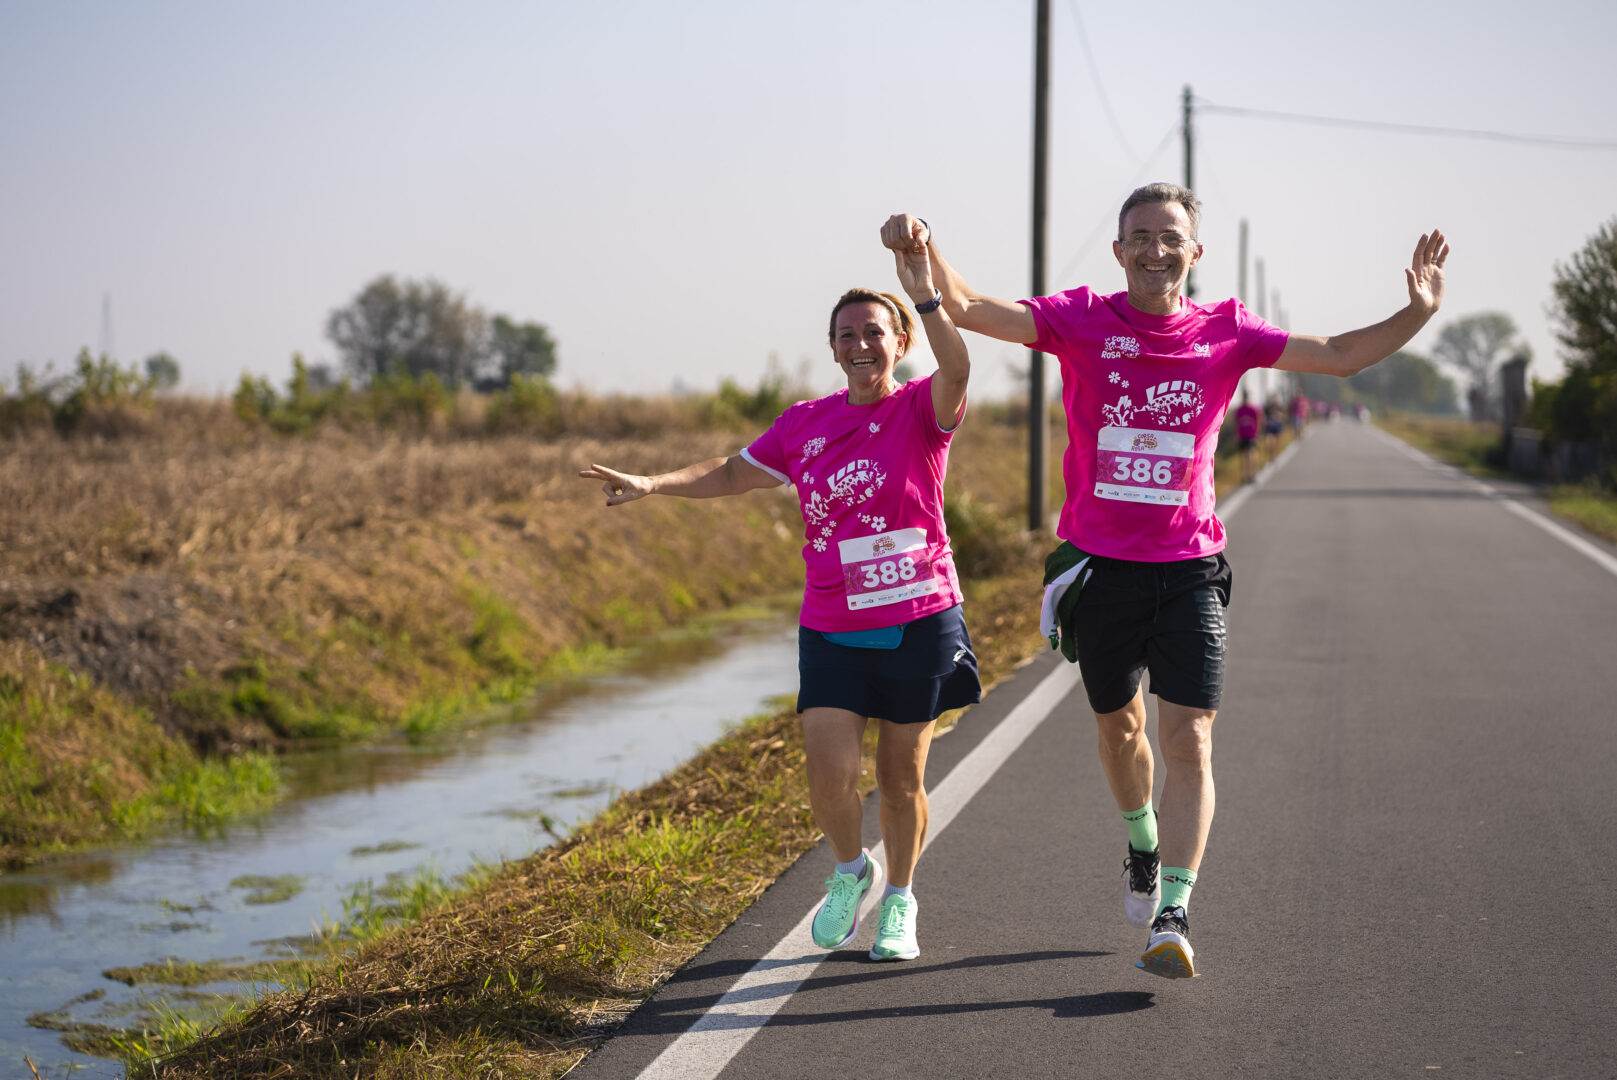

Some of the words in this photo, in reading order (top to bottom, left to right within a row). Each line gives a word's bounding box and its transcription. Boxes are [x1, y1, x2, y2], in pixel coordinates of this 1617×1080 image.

[1111, 335, 1136, 345] CORSA
[1101, 350, 1121, 359] ROSA
[1112, 456, 1172, 485] 386
[860, 556, 917, 588] 388
